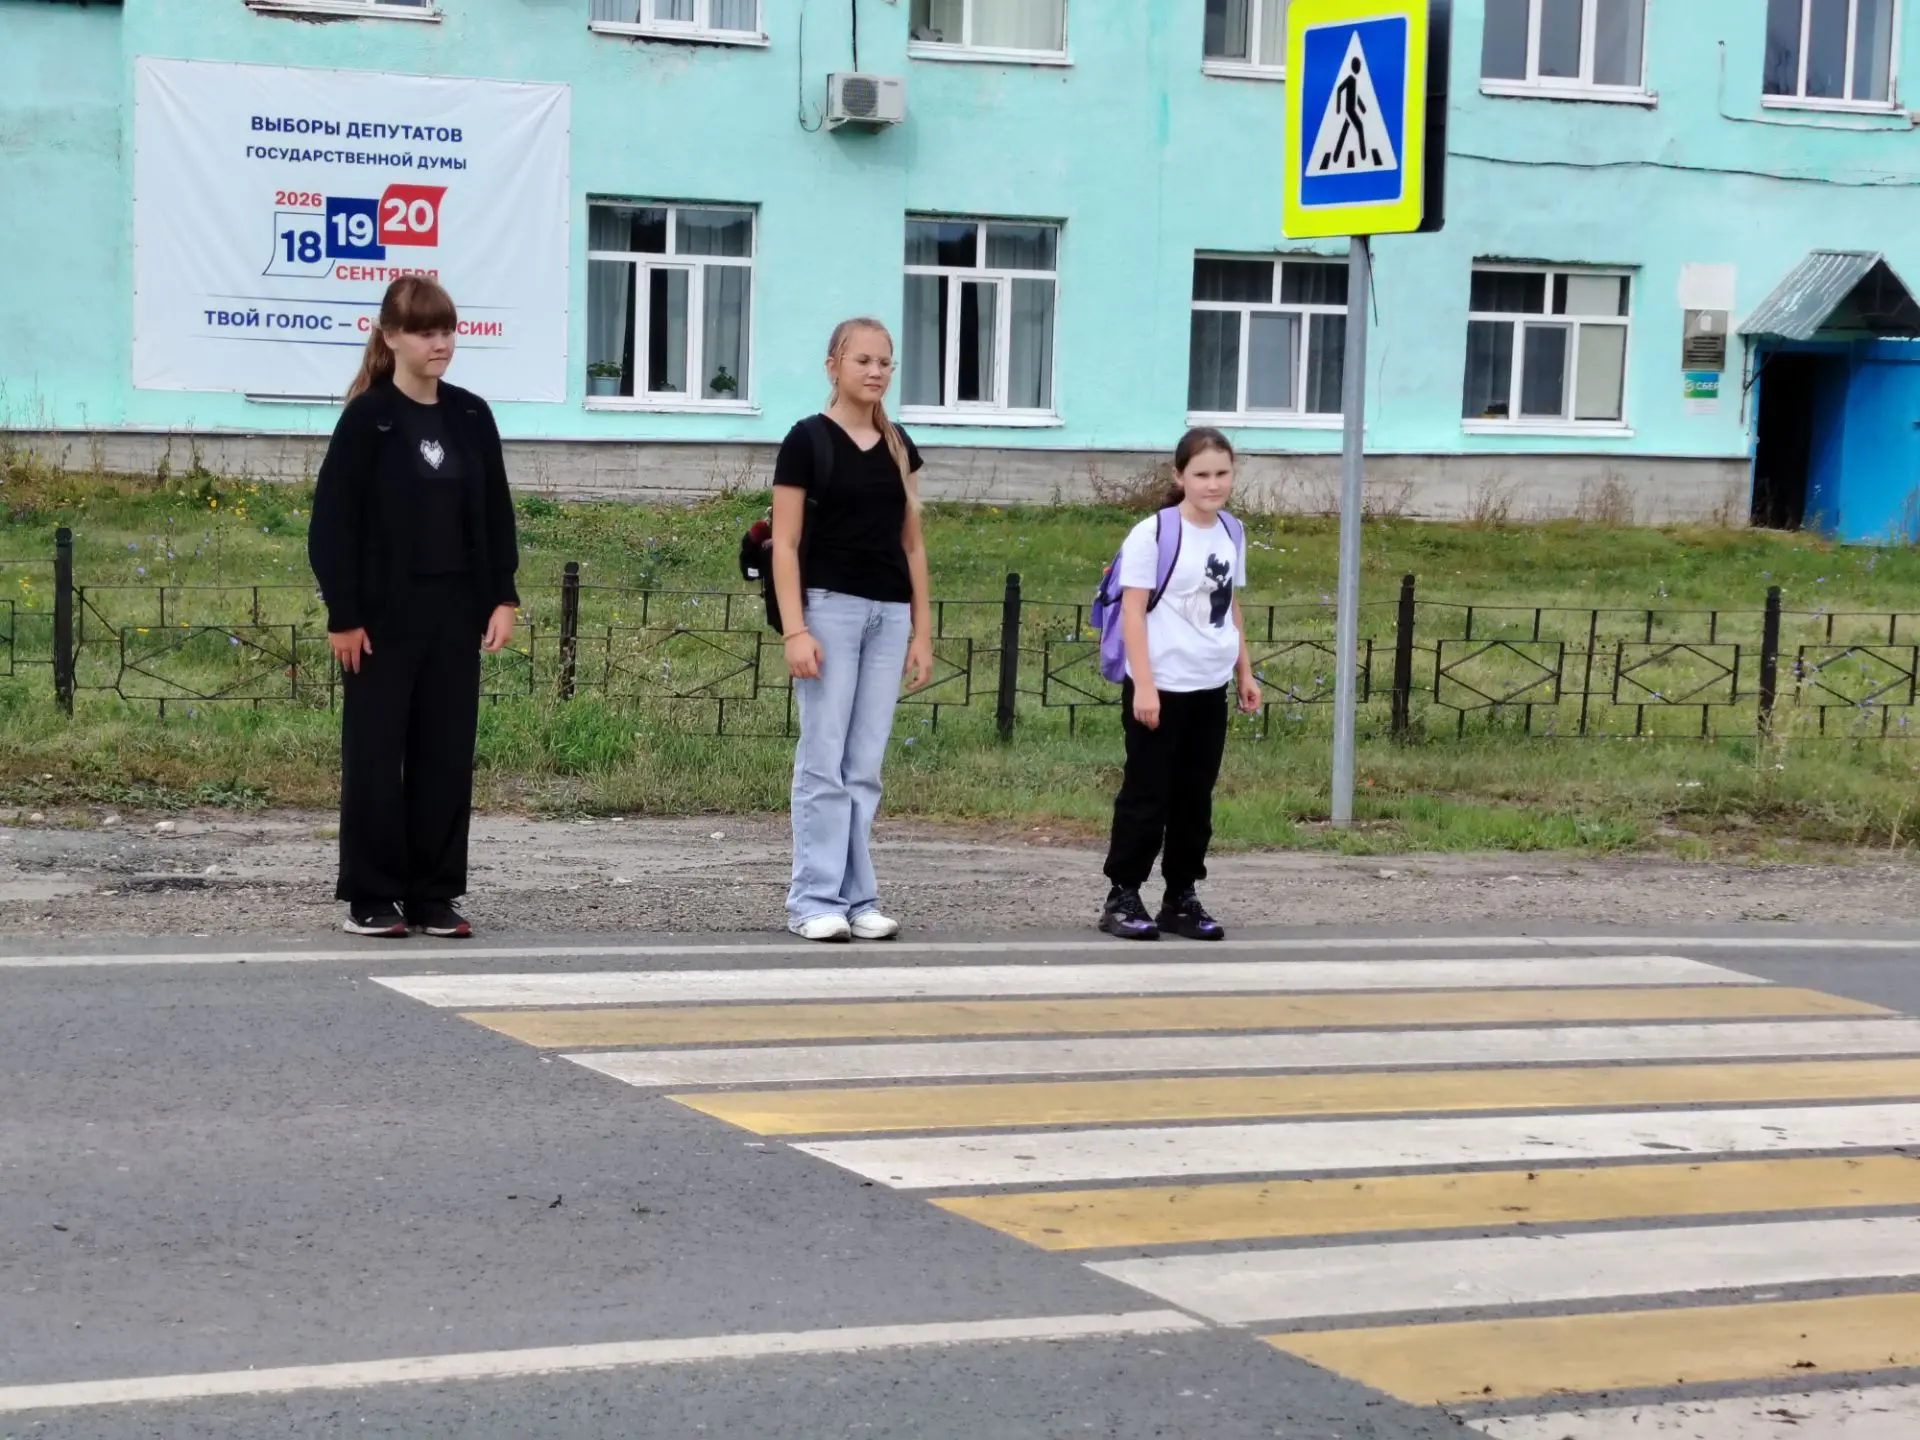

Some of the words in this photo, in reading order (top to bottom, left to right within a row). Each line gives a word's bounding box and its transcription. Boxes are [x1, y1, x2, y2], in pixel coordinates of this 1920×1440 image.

[251, 116, 340, 136] ВЫБОРЫ
[346, 122, 463, 143] ДЕПУТАТОВ
[246, 146, 413, 167] ГОСУДАРСТВЕННОЙ
[417, 155, 467, 170] ДУМЫ
[275, 191, 323, 207] 2026
[281, 229, 322, 263] 18
[332, 212, 374, 247] 19
[383, 198, 434, 233] 20
[204, 310, 260, 327] ТВОЙ
[266, 313, 332, 330] ГОЛОС
